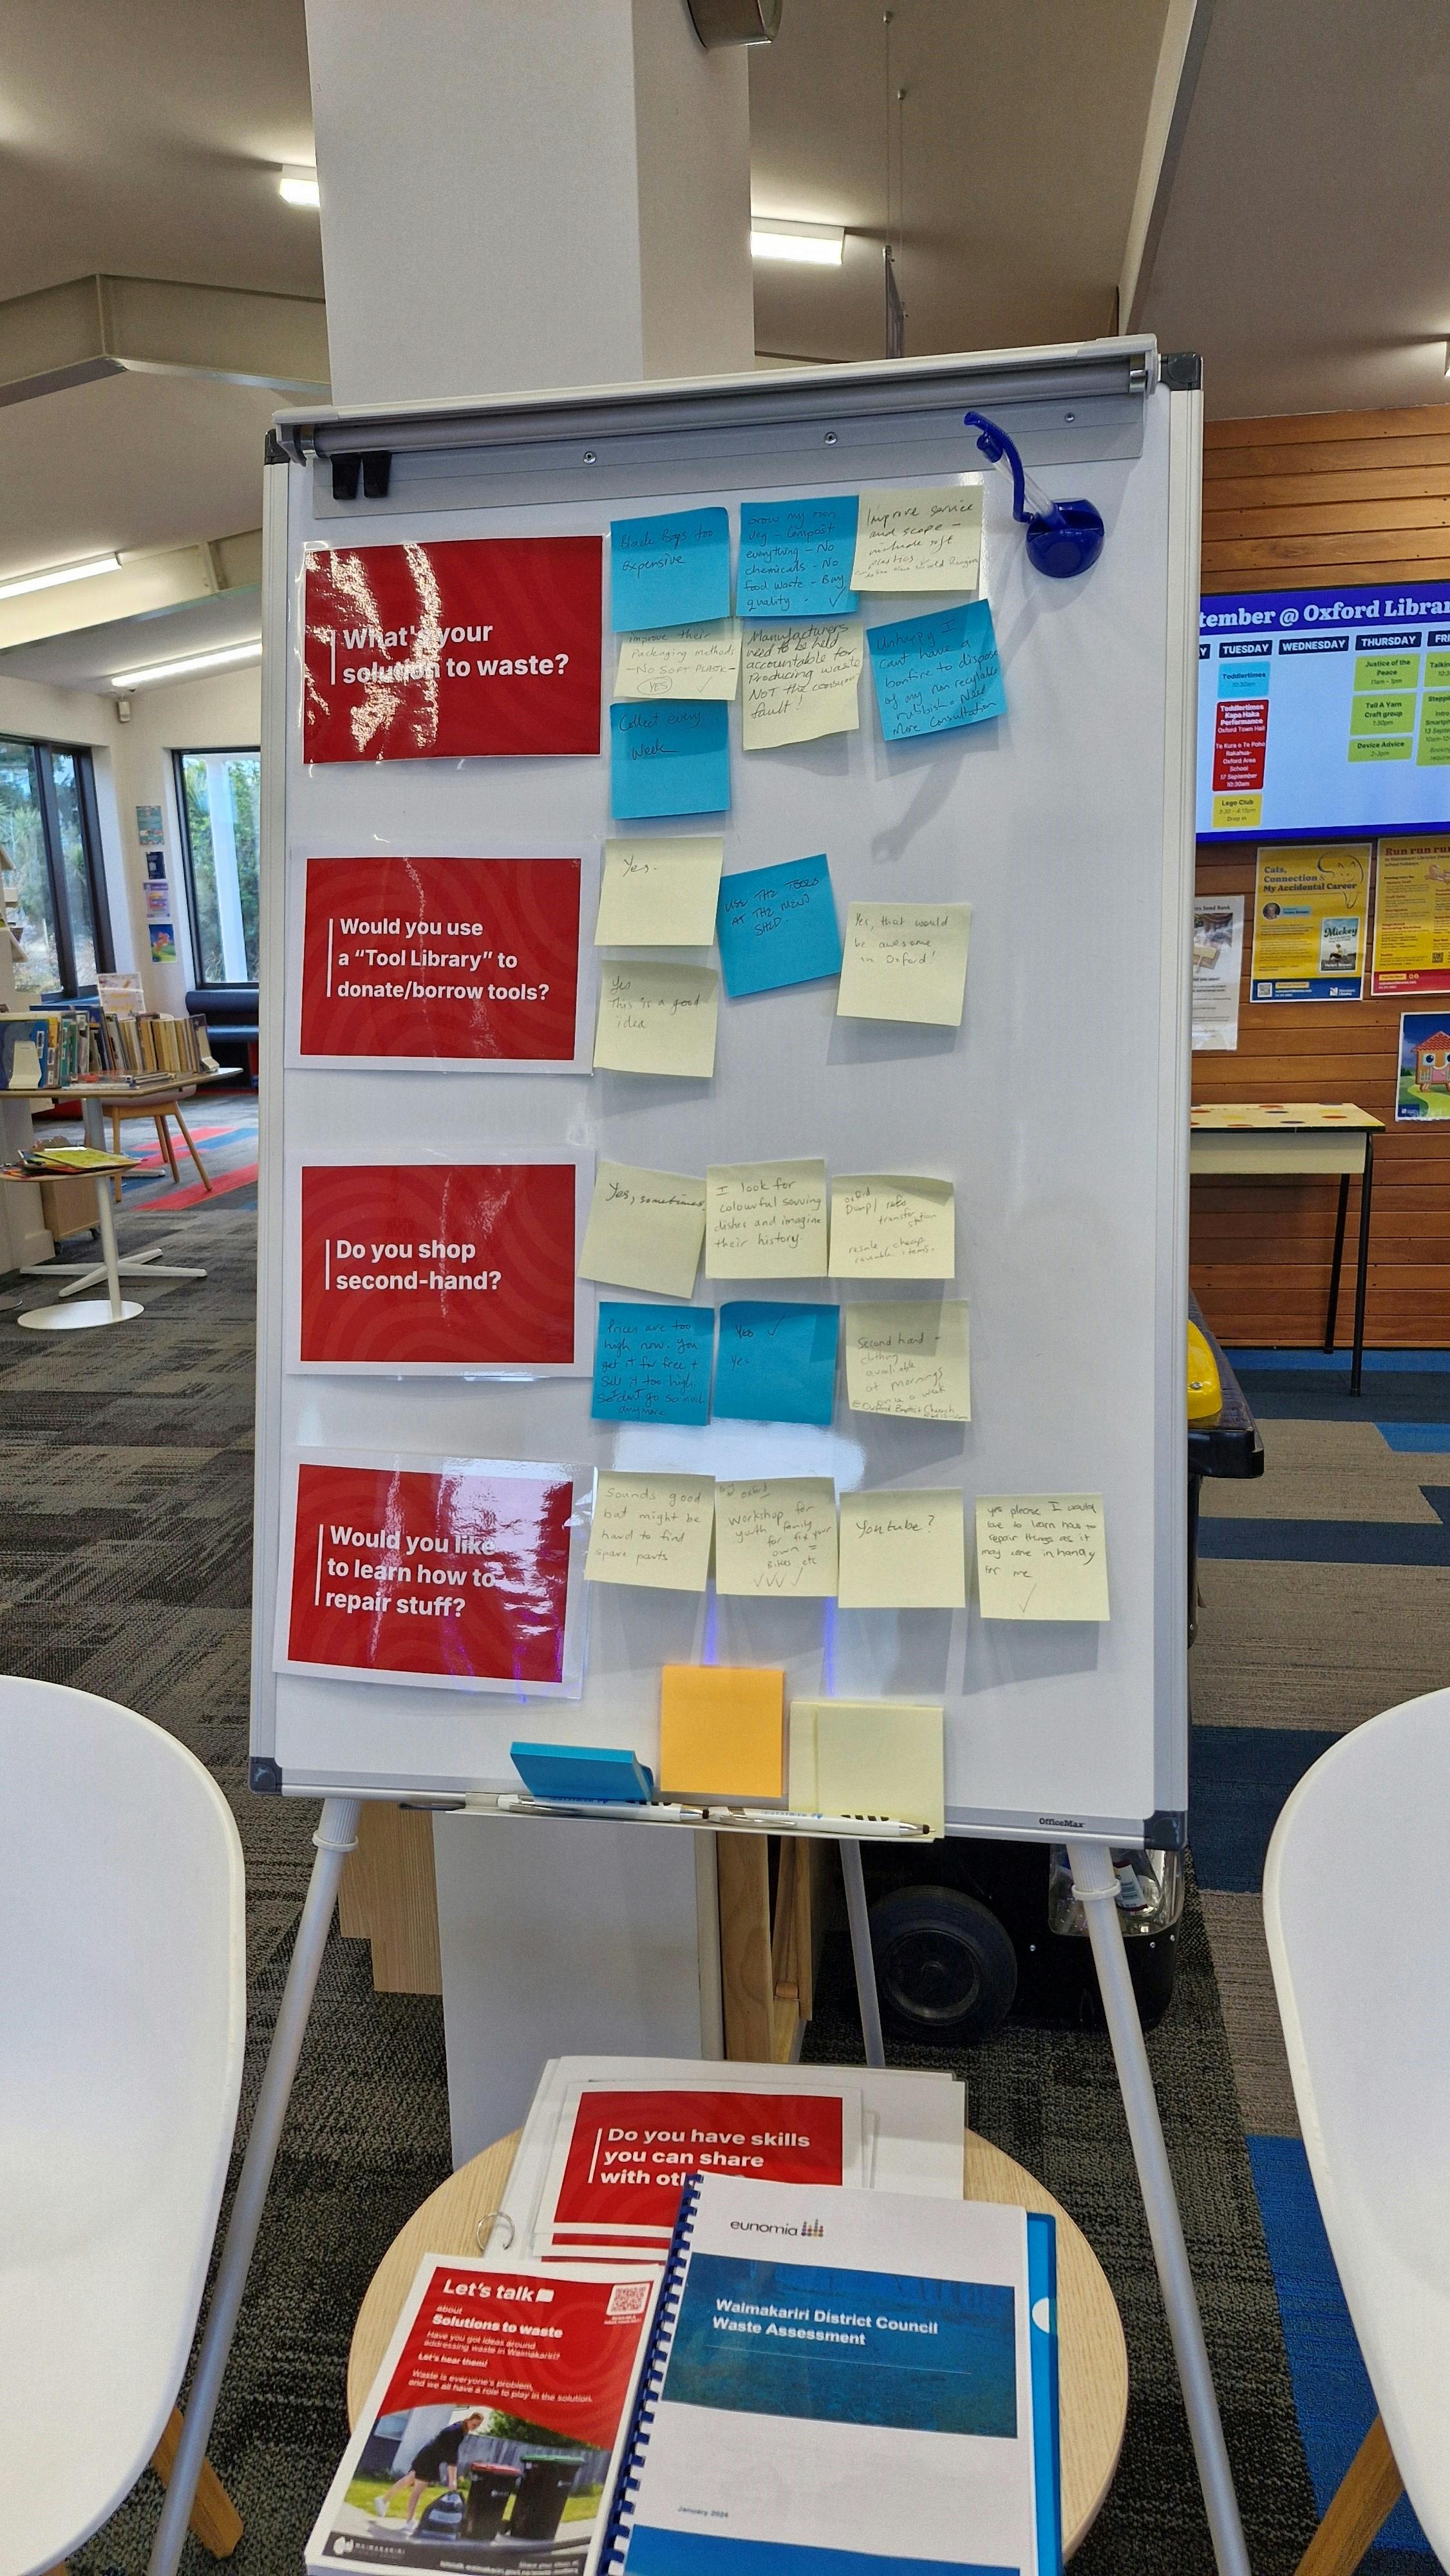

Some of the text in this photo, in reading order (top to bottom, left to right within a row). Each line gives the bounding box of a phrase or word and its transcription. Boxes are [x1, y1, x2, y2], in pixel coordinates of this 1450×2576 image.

[903, 524, 943, 536] scope
[746, 541, 834, 563] everything No
[623, 554, 686, 577] expensive
[746, 562, 805, 574] chemicals
[822, 558, 838, 569] No
[744, 578, 804, 591] food waste
[747, 596, 790, 612] quality
[1303, 601, 1380, 621] Oxford
[435, 625, 493, 648] your
[747, 632, 839, 658] need held
[1223, 636, 1416, 654] TUESDAY WEDNESDAY THURSDAY
[746, 647, 856, 670] accountable for
[919, 645, 955, 659] have
[446, 658, 471, 677] to
[477, 654, 569, 676] waste?
[886, 662, 953, 688] bonfire to
[340, 918, 484, 938] Would you use
[880, 916, 948, 927] that would
[1324, 927, 1357, 937] Mickey
[854, 939, 865, 947] be
[338, 950, 517, 971] a "Tool Library" to
[337, 981, 549, 1000] donate/borrow tools?
[670, 994, 700, 1015] good
[616, 1016, 646, 1028] idea
[717, 1177, 796, 1195] I look for
[720, 1197, 777, 1212] colourful
[715, 1215, 821, 1231] dishes and imagine
[336, 1240, 476, 1263] Do you shop
[715, 1238, 748, 1247] their
[336, 1271, 501, 1290] second-hand?
[605, 1338, 630, 1356] high
[663, 1356, 684, 1369] free
[605, 1488, 701, 1507] Sounds good
[603, 1507, 701, 1525] but might be
[1011, 1501, 1062, 1518] please I
[1031, 1520, 1056, 1529] learn
[330, 1526, 495, 1555] Would you like
[602, 1530, 684, 1542] hard to find
[989, 1534, 1018, 1544] repair
[637, 1551, 668, 1566] parts
[982, 1549, 1001, 1559] may
[328, 1558, 495, 1587] to learn how to
[325, 1592, 466, 1616] repair stuff?
[1039, 1818, 1086, 1828] OfficeMax
[608, 2128, 811, 2148] Do you have skills
[603, 2150, 764, 2168] you can share
[601, 2169, 649, 2184] with
[730, 2220, 798, 2236] eunomia
[443, 2279, 534, 2302] Let's talk
[437, 2305, 462, 2315] about
[716, 2298, 938, 2334] Waimakariri District Council
[433, 2314, 563, 2338] Solutions to waste
[713, 2316, 866, 2345] Waste Assessment
[424, 2340, 469, 2352] addressing
[471, 2344, 496, 2354] waste
[427, 2331, 536, 2350] Have you got ideas around
[419, 2353, 460, 2365] Let's hear
[412, 2370, 438, 2380] Waste
[427, 2381, 439, 2389] we
[440, 2381, 450, 2391] all
[452, 2383, 473, 2393] have
[483, 2386, 499, 2396] role
[501, 2389, 509, 2397] to
[511, 2391, 529, 2400] play
[531, 2391, 540, 2400] in
[541, 2392, 555, 2401] the
